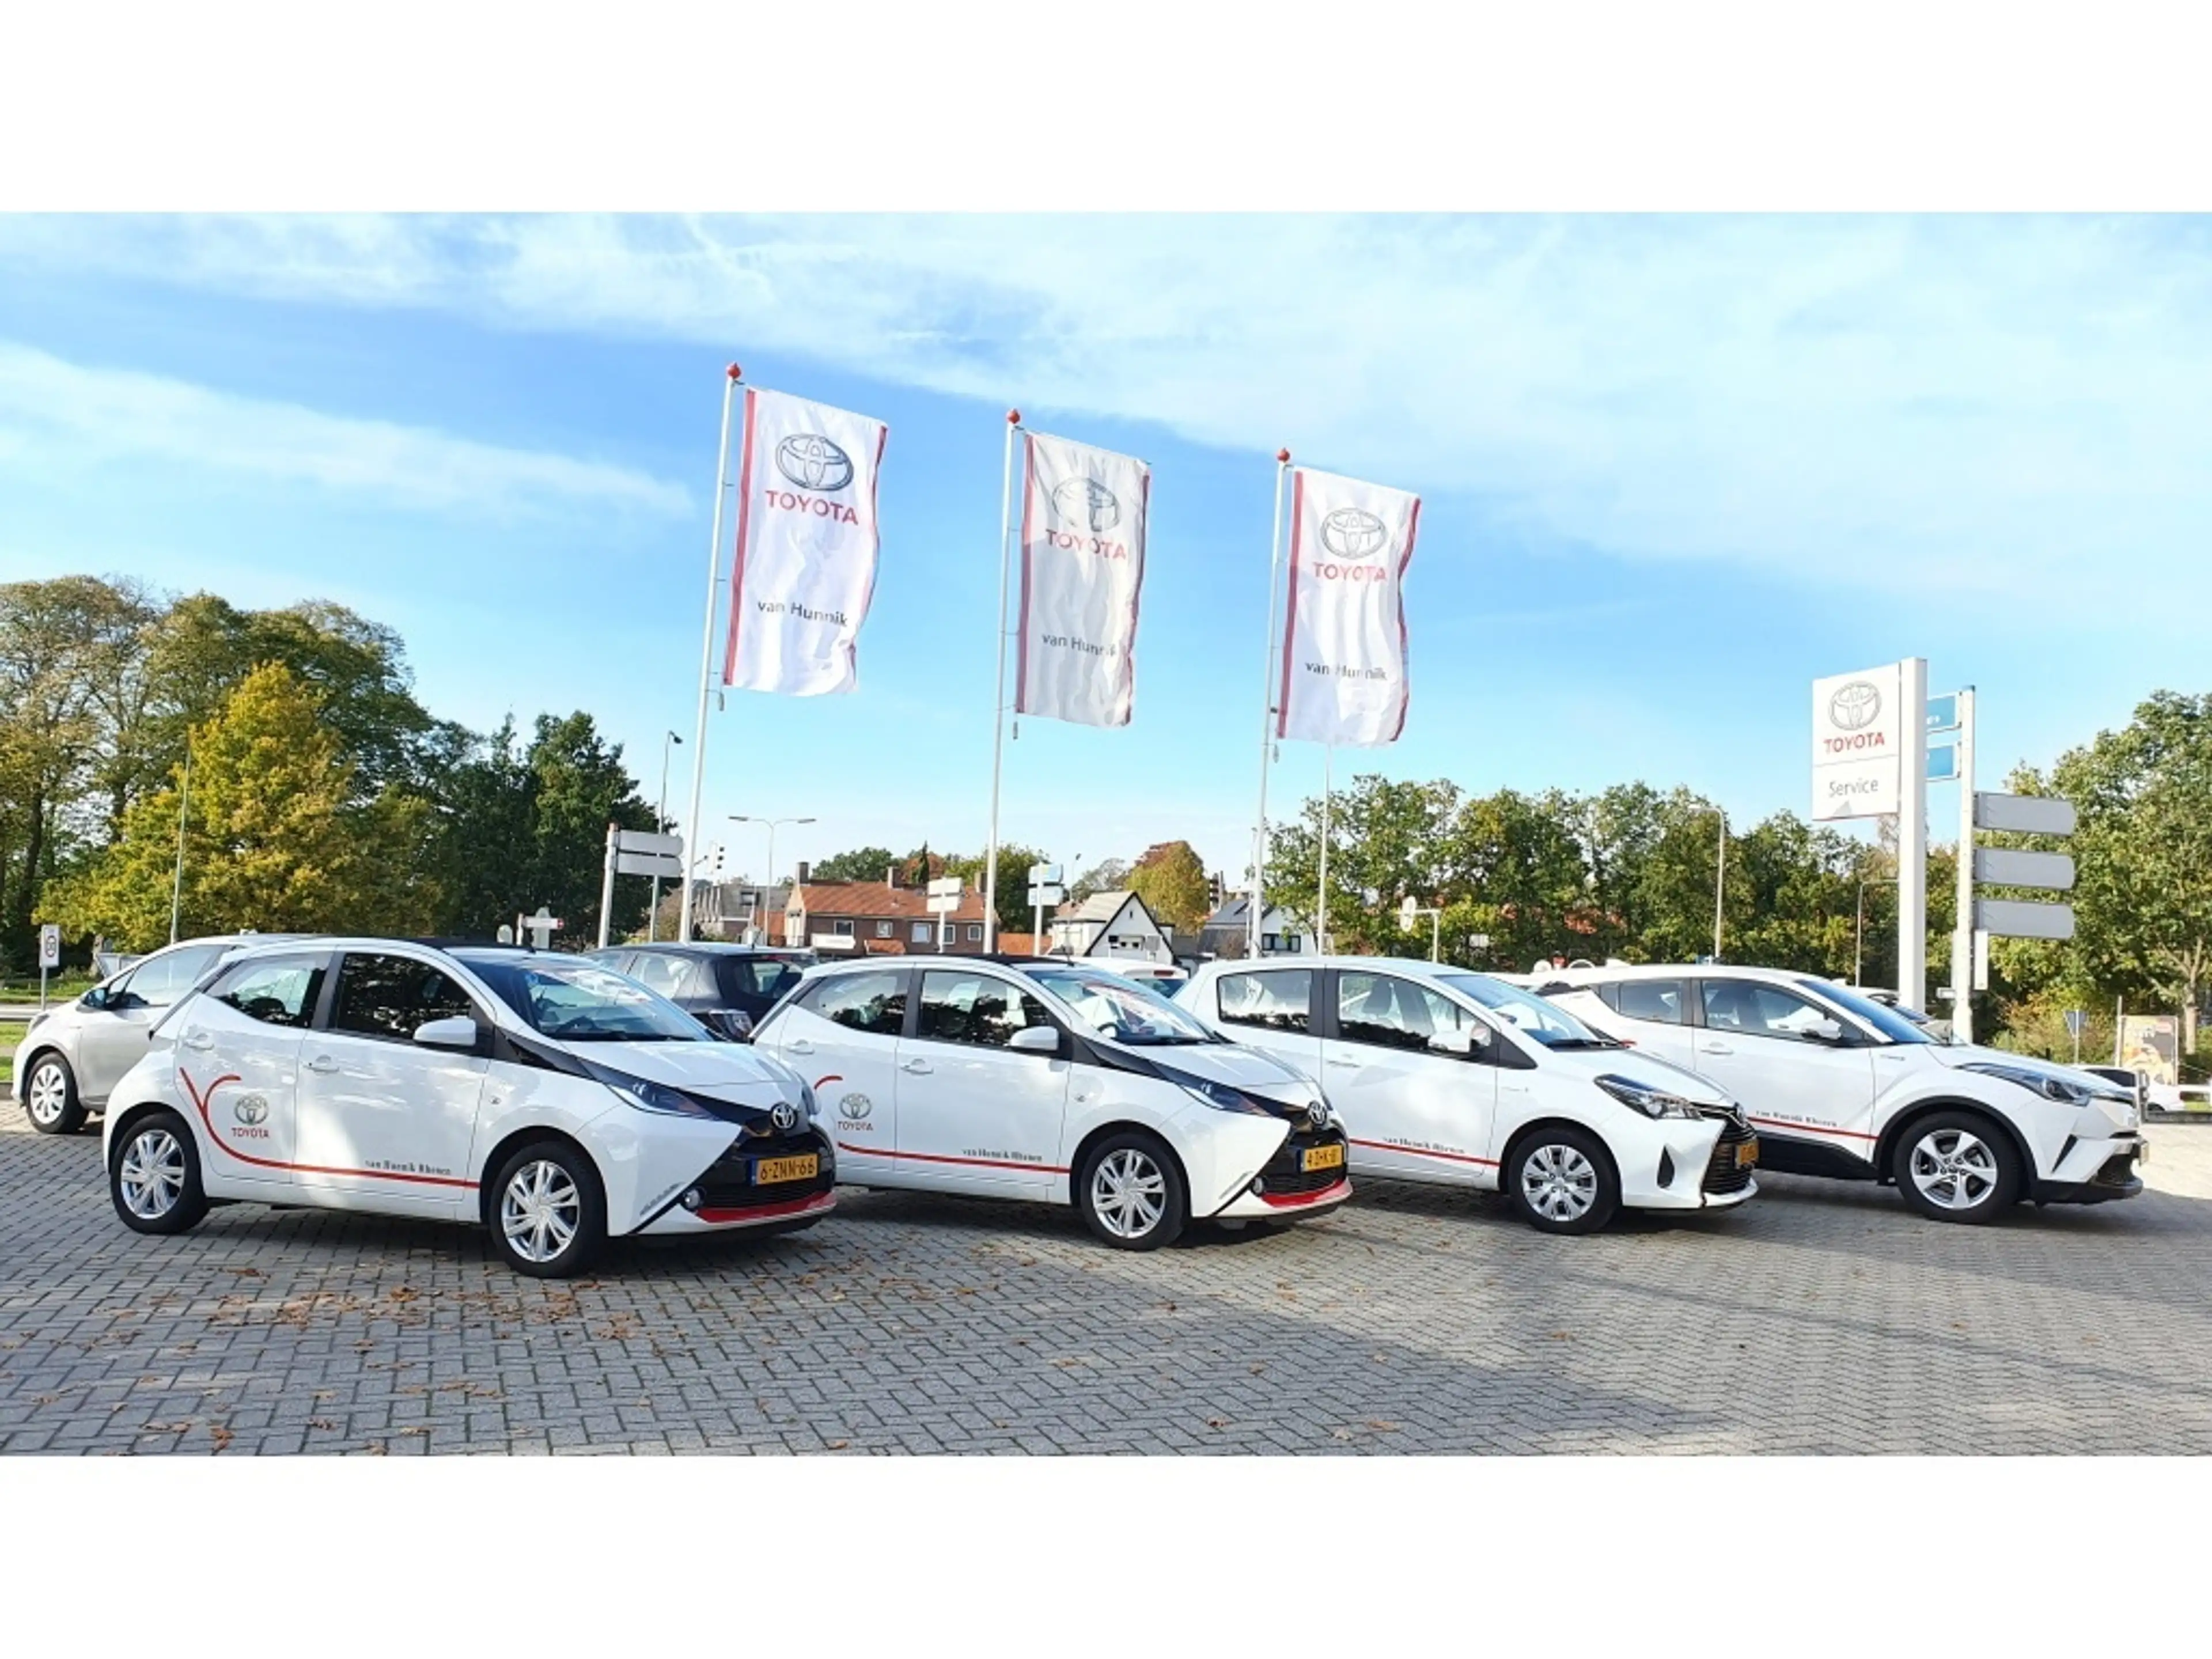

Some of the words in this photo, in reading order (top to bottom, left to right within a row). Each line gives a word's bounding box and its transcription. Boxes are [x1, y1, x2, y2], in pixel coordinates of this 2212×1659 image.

[765, 490, 859, 526] TOYOTA
[1046, 528, 1127, 560] TOYOTA
[1313, 561, 1388, 582] TOYOTA
[757, 601, 785, 613] van
[790, 601, 848, 627] Hunnik
[1041, 634, 1067, 647] van
[1305, 662, 1330, 675] van
[1823, 732, 1885, 754] TOYOTA
[1829, 777, 1879, 798] Service
[232, 1127, 270, 1139] TOYOTA
[760, 1157, 816, 1181] 6-ZNN-66
